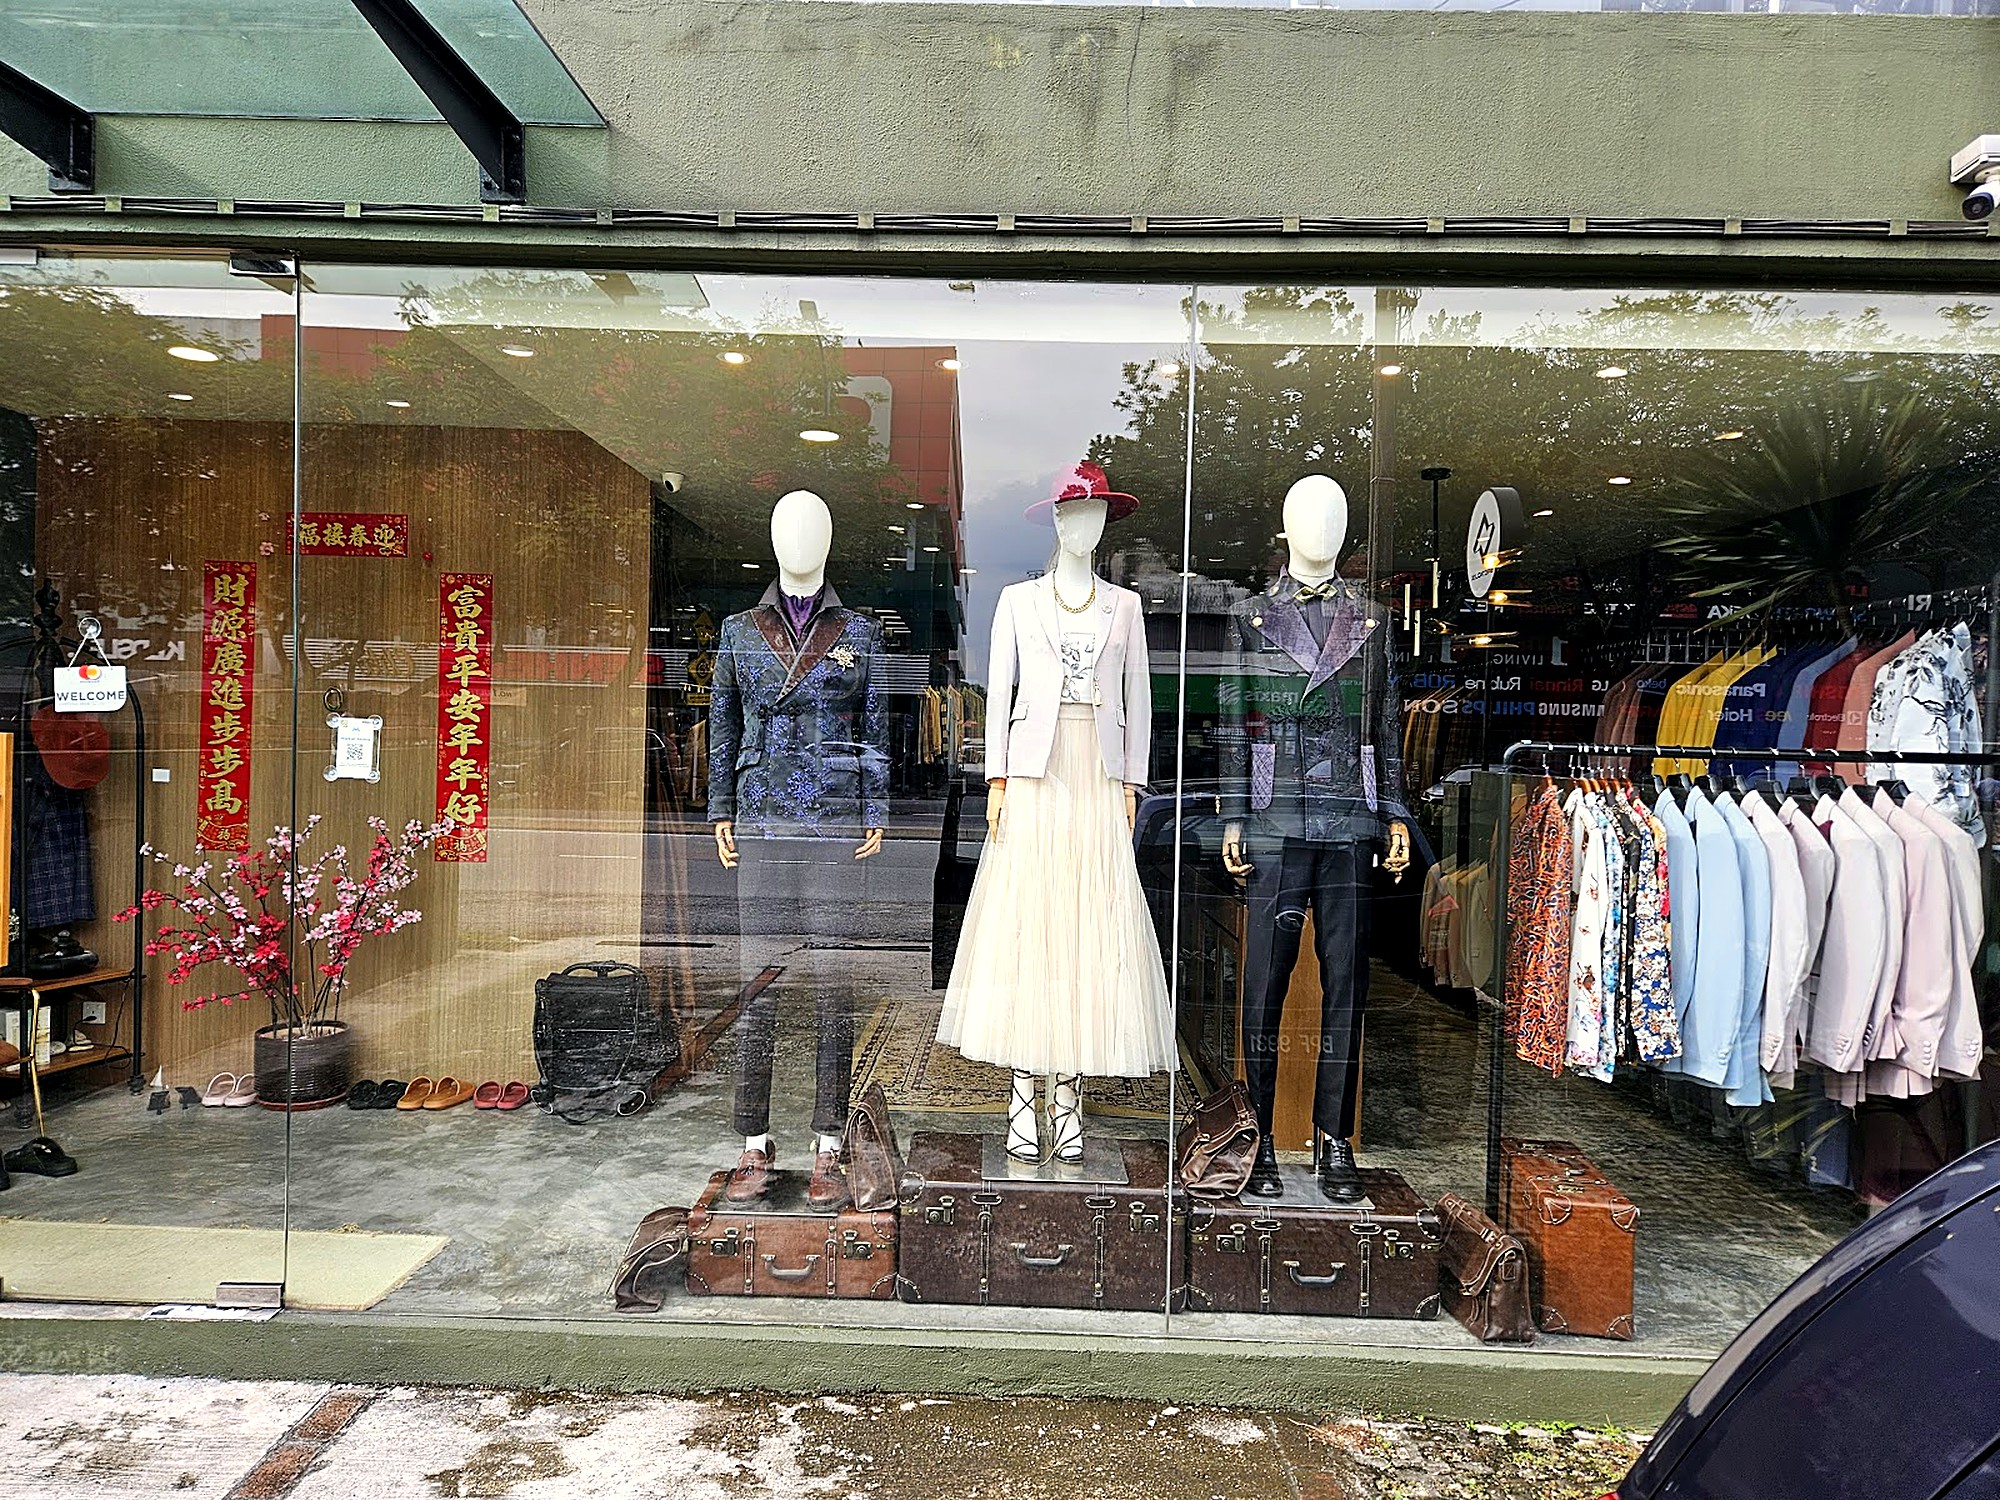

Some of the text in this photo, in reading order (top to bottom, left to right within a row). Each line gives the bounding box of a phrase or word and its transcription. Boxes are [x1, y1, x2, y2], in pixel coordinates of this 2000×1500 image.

[56, 690, 125, 702] WELCOME
[443, 584, 487, 825] 富貴平安年年好
